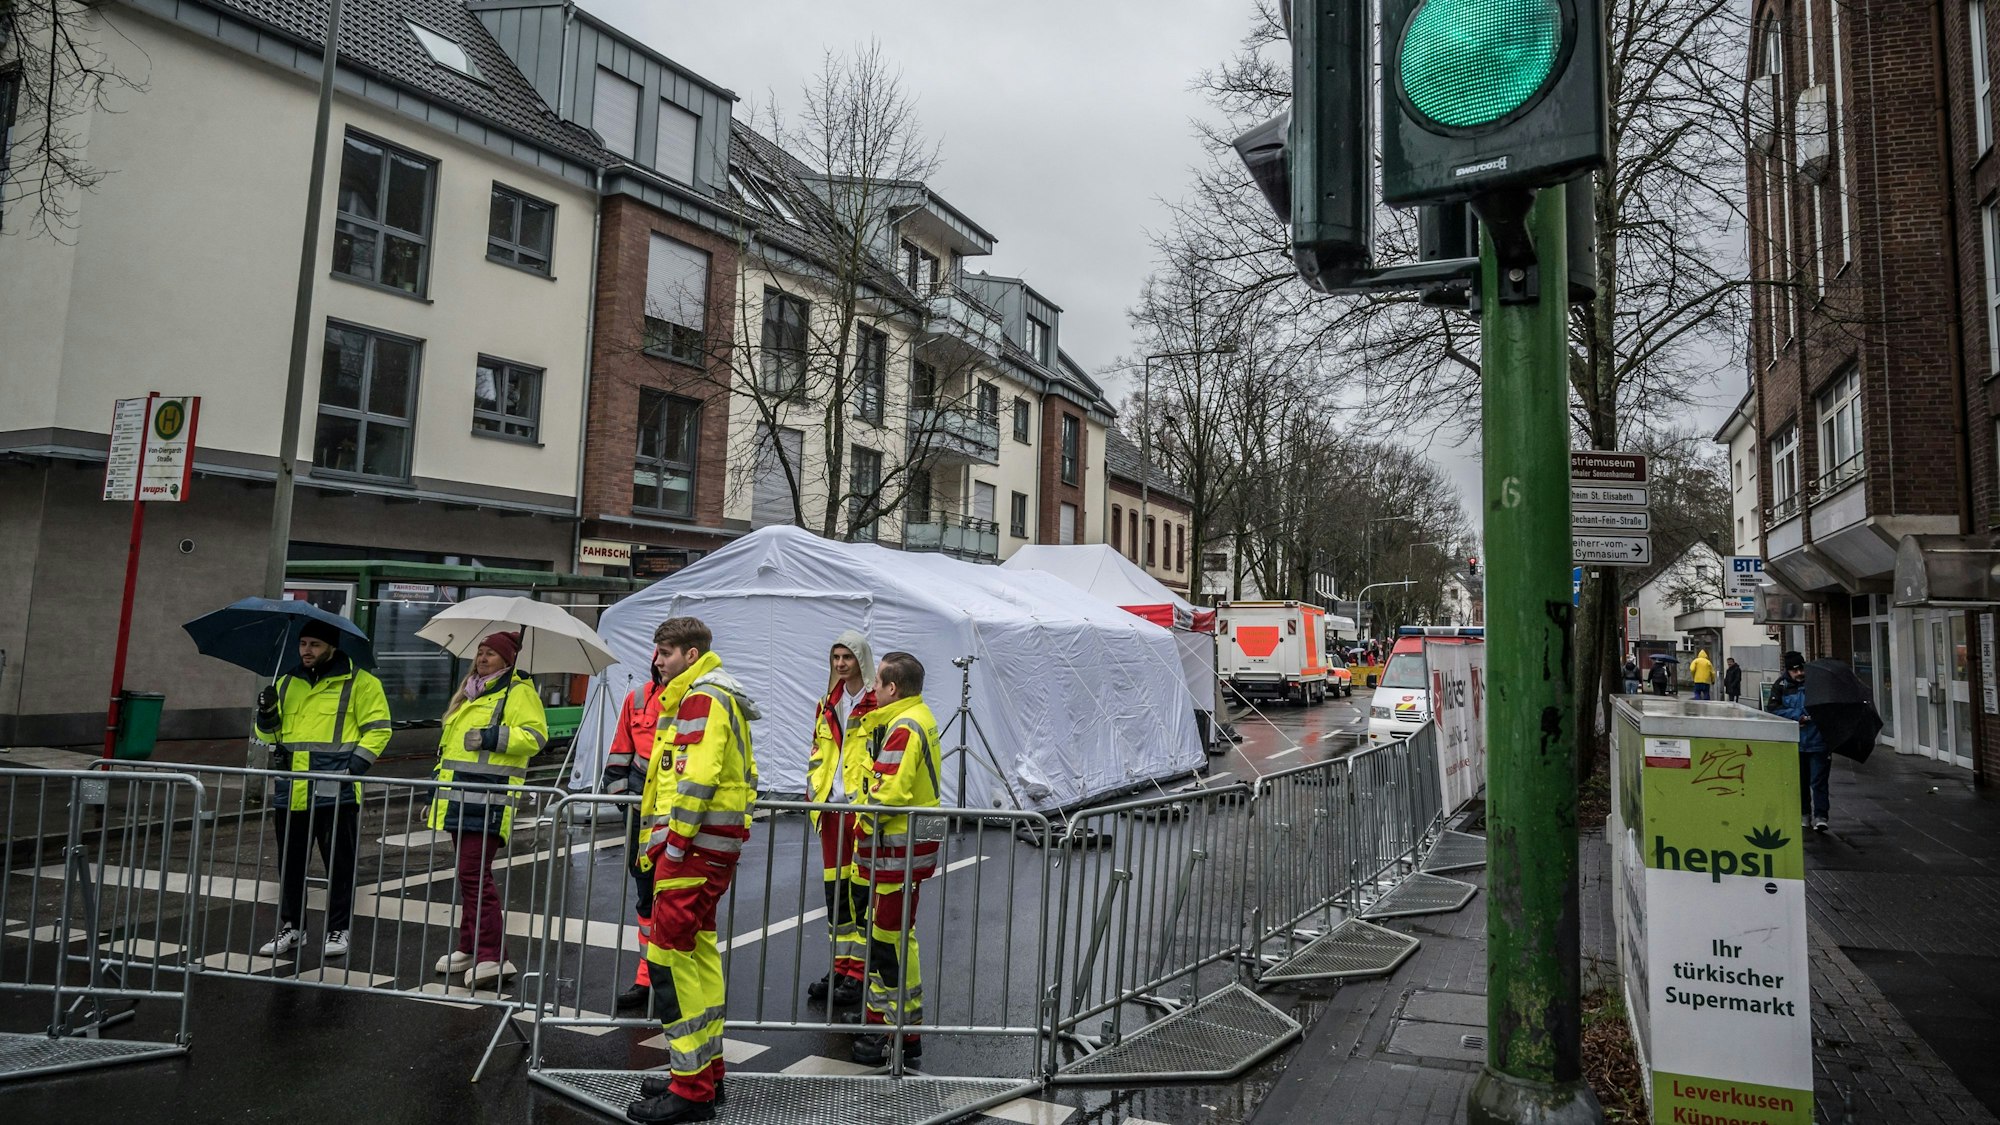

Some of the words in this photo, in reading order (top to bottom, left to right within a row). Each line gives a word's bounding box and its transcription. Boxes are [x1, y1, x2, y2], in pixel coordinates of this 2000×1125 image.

[1456, 161, 1493, 176] swarco
[162, 409, 177, 431] H
[148, 447, 184, 455] Von-Diergardt-
[1572, 456, 1636, 468] striemuseum
[143, 483, 168, 494] wupsi
[1591, 491, 1600, 500] St.
[1603, 492, 1634, 501] Elisabeth
[1573, 540, 1628, 549] eiherr-vom-
[1575, 549, 1629, 560] Gymnasium
[393, 584, 430, 592] FAHRSCHULE
[1655, 835, 1774, 883] hepsi
[1712, 939, 1743, 959] Ihr
[1673, 962, 1784, 989] türkischer
[1665, 986, 1795, 1017] Supermarkt
[1673, 1080, 1794, 1113] Leverkusen
